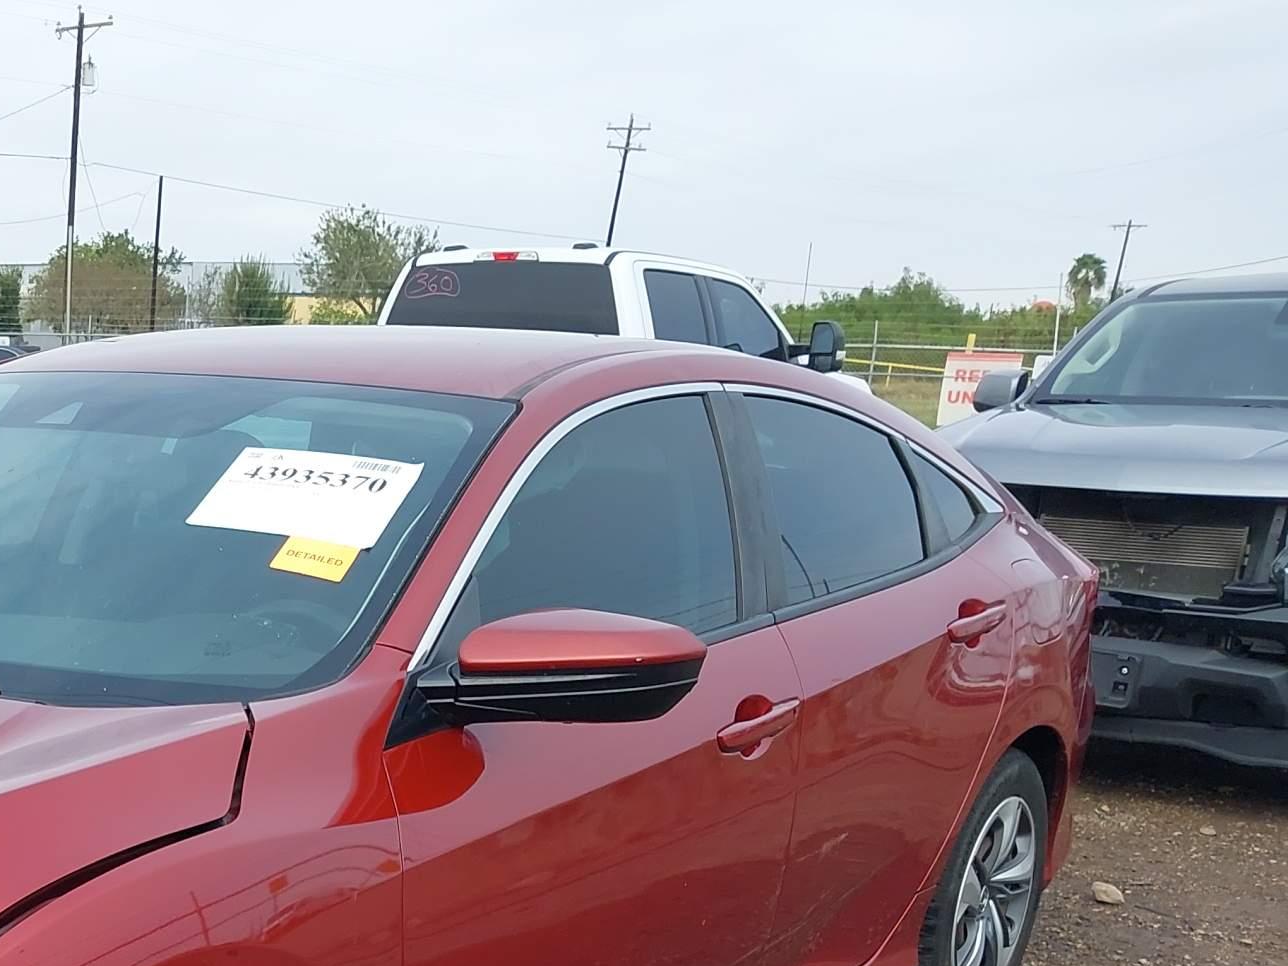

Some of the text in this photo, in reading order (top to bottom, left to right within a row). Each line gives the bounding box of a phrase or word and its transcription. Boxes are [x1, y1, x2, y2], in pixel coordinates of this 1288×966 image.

[409, 272, 453, 293] 360
[243, 465, 388, 493] 43935370
[286, 549, 344, 567] DETAILED
